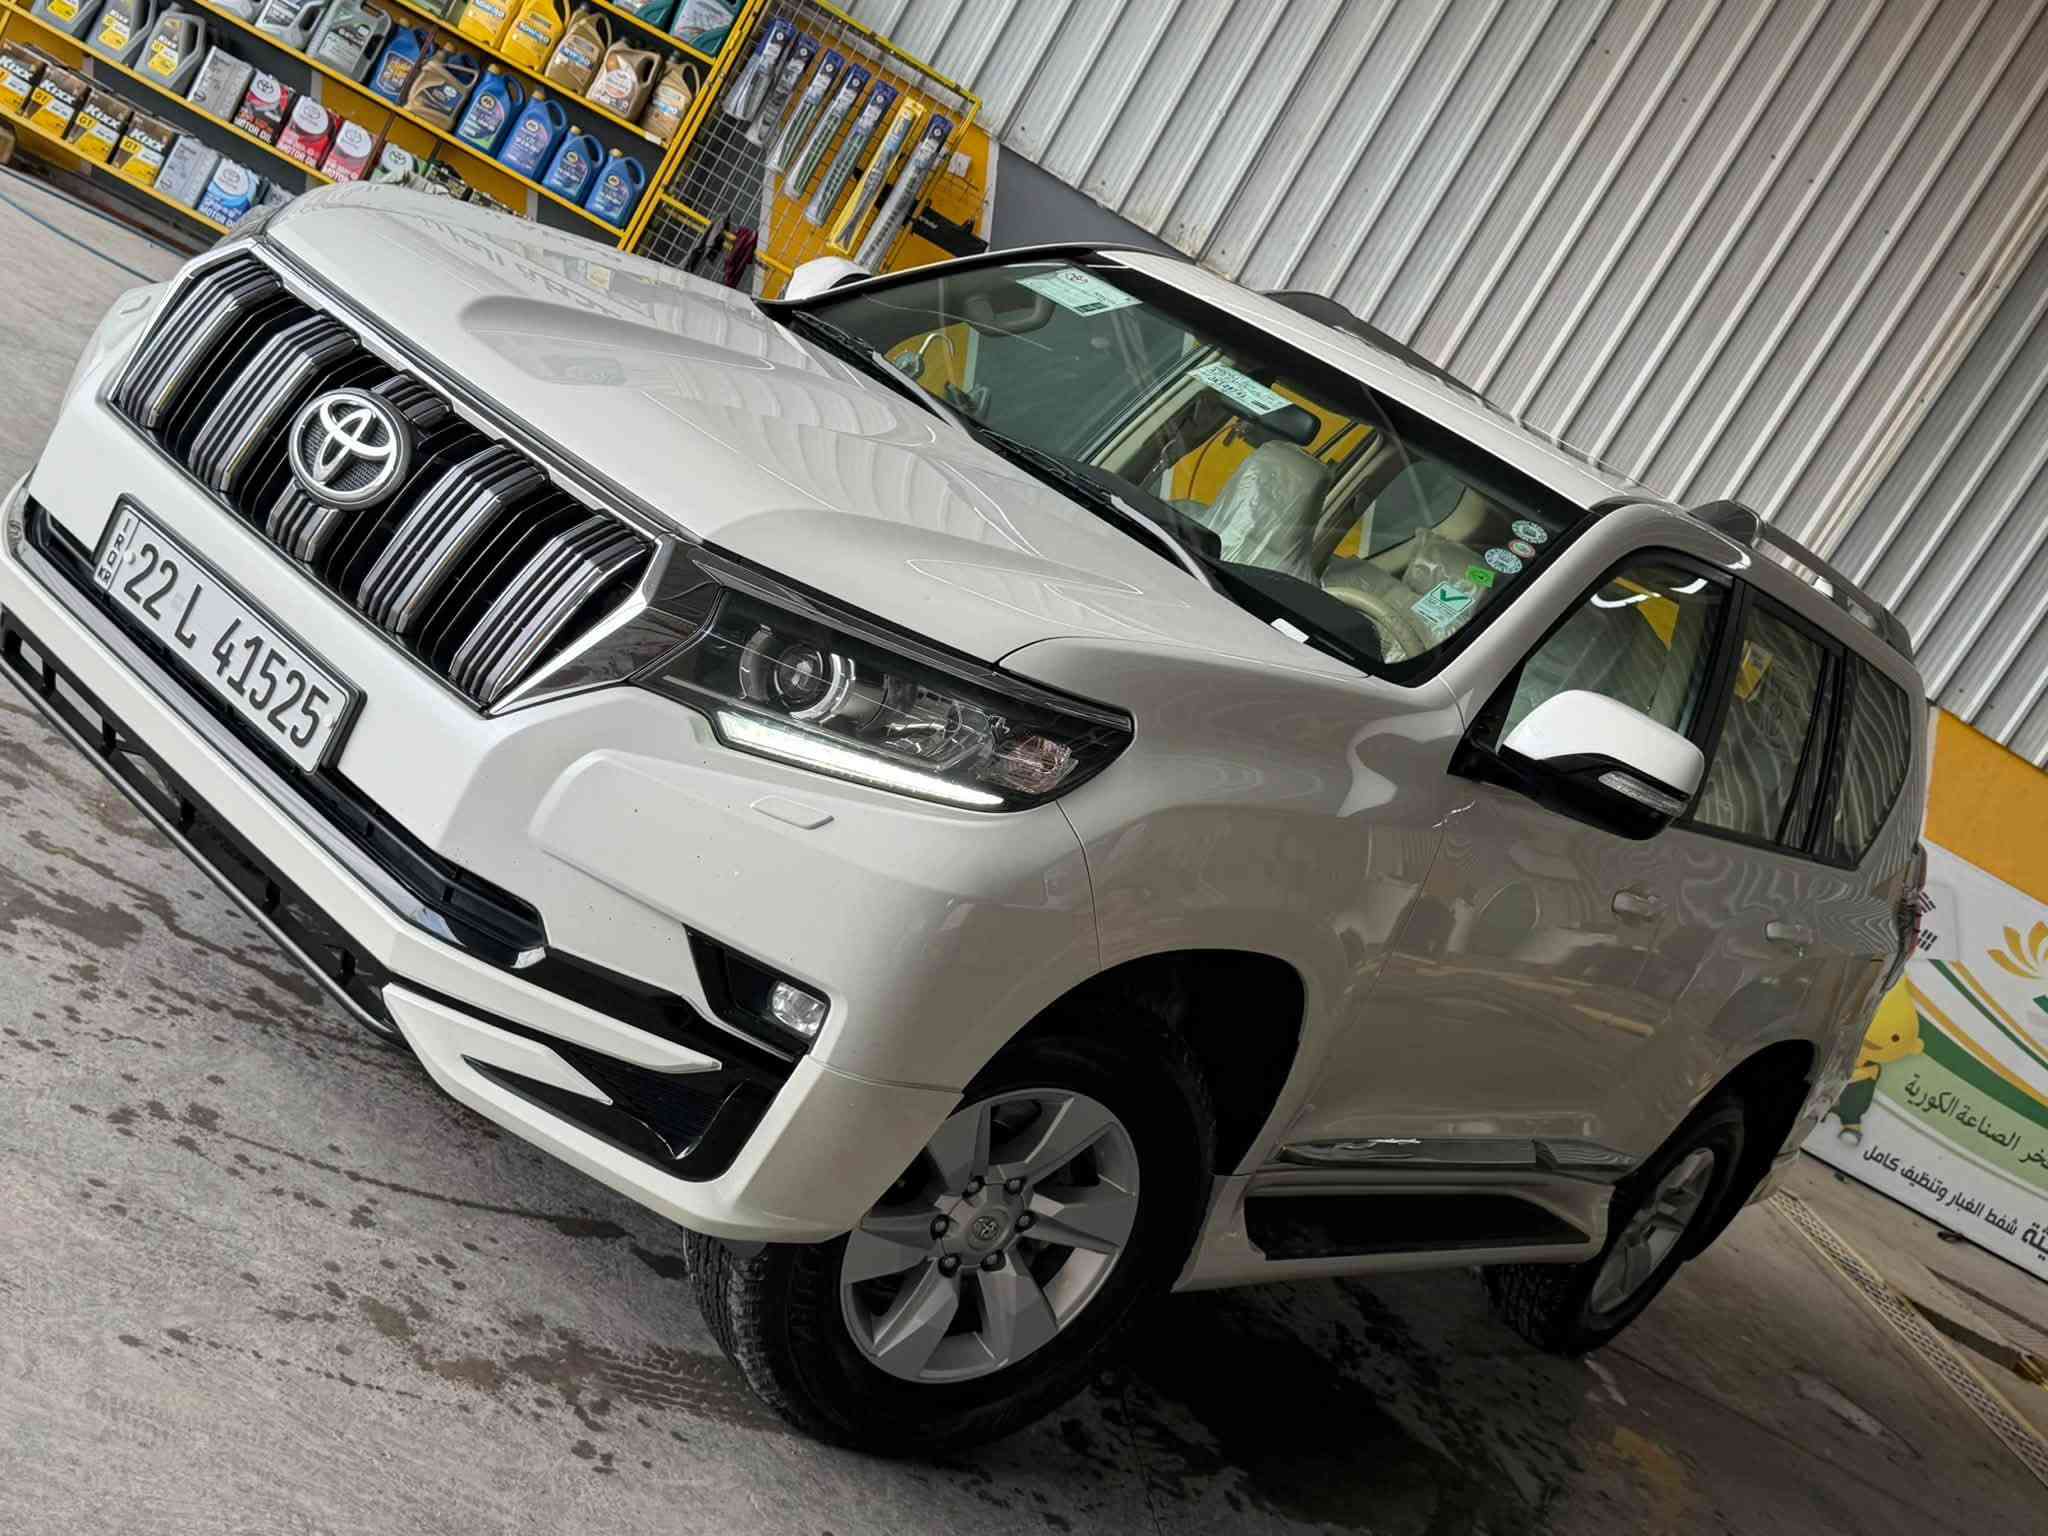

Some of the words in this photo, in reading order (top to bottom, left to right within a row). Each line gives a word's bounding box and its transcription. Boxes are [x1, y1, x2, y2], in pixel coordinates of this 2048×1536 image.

[34, 91, 49, 103] G1
[39, 79, 76, 105] Kixx
[79, 115, 94, 127] G1
[84, 103, 121, 130] Kixx
[123, 139, 139, 152] G1
[129, 127, 165, 153] Kixx
[123, 543, 179, 621] 22
[174, 583, 203, 649] L
[211, 617, 331, 749] 41525
[1904, 1073, 1960, 1117] الكورية
[1955, 1105, 2021, 1151] الصناعة
[1863, 1145, 1901, 1173] كامل
[2018, 1148, 2048, 1170] خر
[1900, 1165, 1949, 1202] وتنظيف
[1945, 1191, 1986, 1217] الغبار
[1984, 1208, 2018, 1236] شفط
